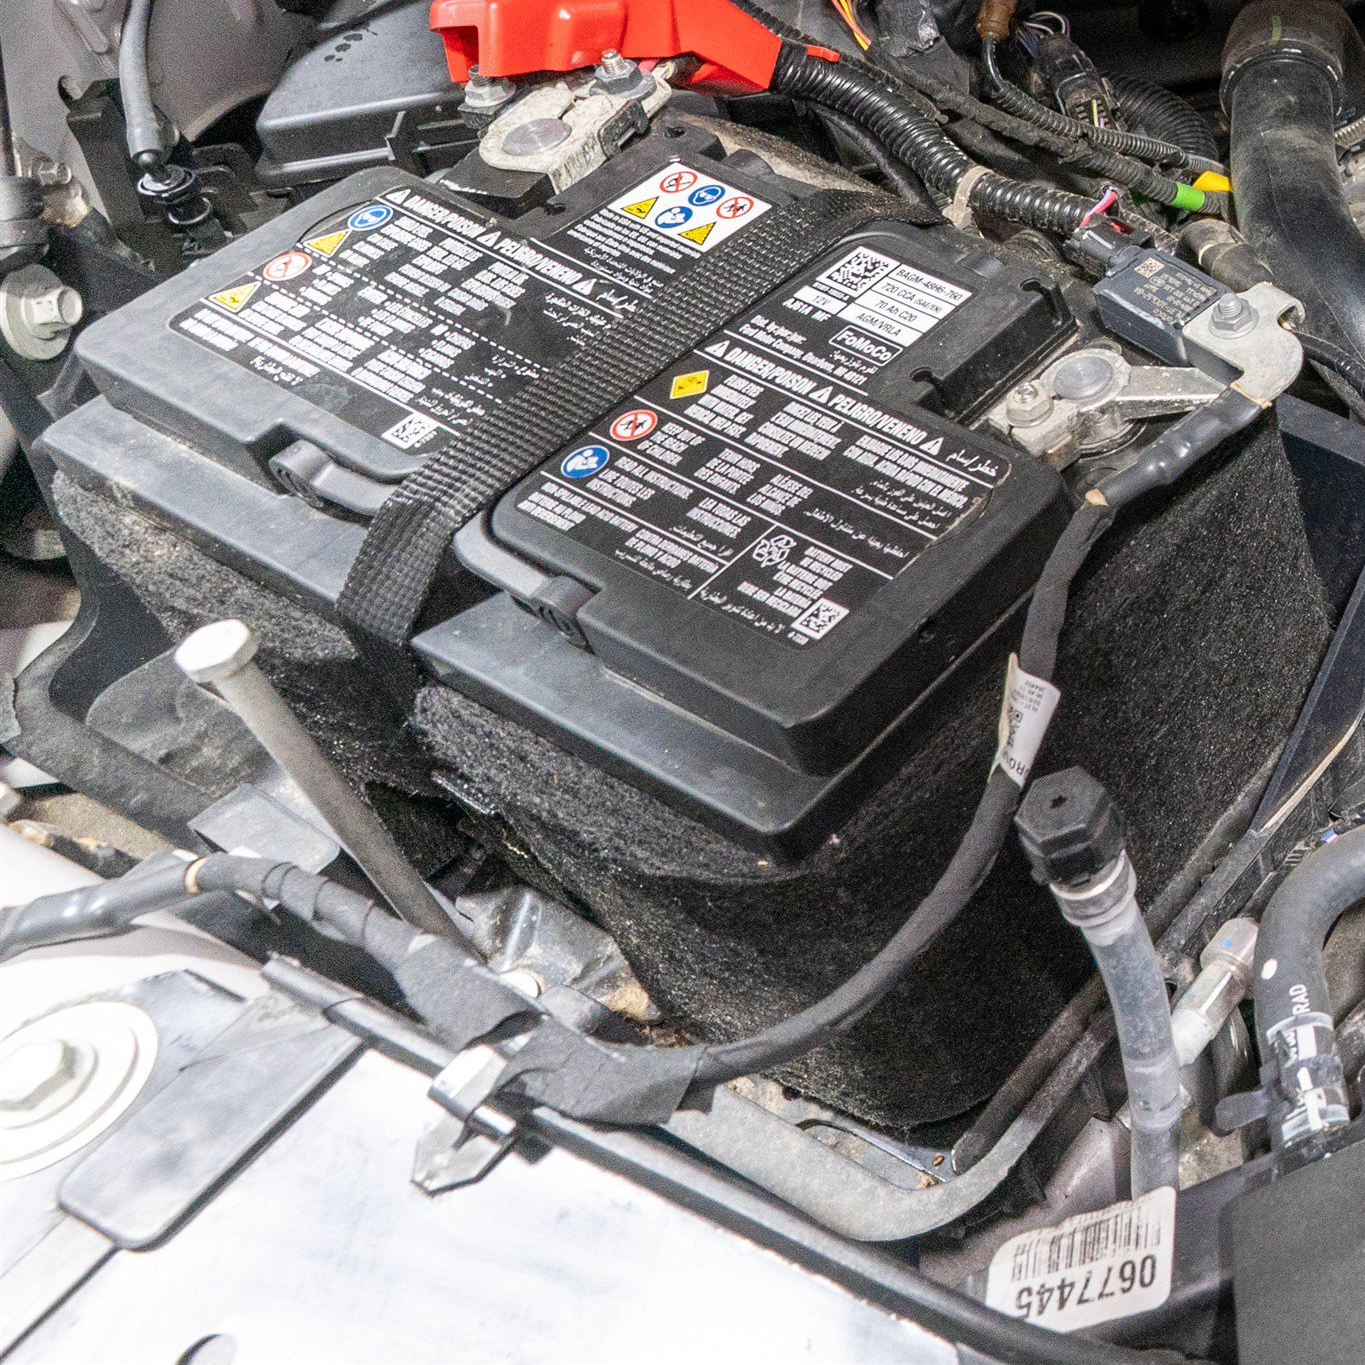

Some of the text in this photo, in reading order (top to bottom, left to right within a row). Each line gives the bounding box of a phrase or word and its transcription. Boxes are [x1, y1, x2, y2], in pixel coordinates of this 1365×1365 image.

[401, 195, 486, 238] DANGER/POISON
[492, 238, 583, 285] PELIGRO/VENENO
[895, 269, 963, 300] BAGM-48H6-760
[810, 295, 831, 306] 12V
[880, 283, 942, 313] 720 CCA (SAE/EN)
[873, 300, 918, 321] 70 Ah C20
[854, 313, 903, 335] AGM/VRLA
[834, 331, 896, 360] FoMoCo
[722, 347, 816, 395] DANGER/POISON
[826, 394, 927, 445] PELIGRO/VENENO
[637, 440, 652, 450] OF
[650, 431, 667, 443] THE
[661, 422, 704, 446] KEEP OUT OF
[614, 456, 637, 471] READ
[631, 464, 649, 477] ALL
[694, 467, 712, 479] DES
[706, 458, 720, 468] DE
[715, 462, 729, 472] LA
[598, 468, 654, 499] LIRE TOUTES LES
[746, 493, 765, 505] LOS
[786, 496, 800, 507] DE
[698, 497, 750, 526] LEA TODAS LAS
[777, 560, 790, 570] LA
[773, 586, 787, 596] LA
[1289, 983, 1309, 1015] RAD
[1016, 1254, 1156, 1317] 0677445
